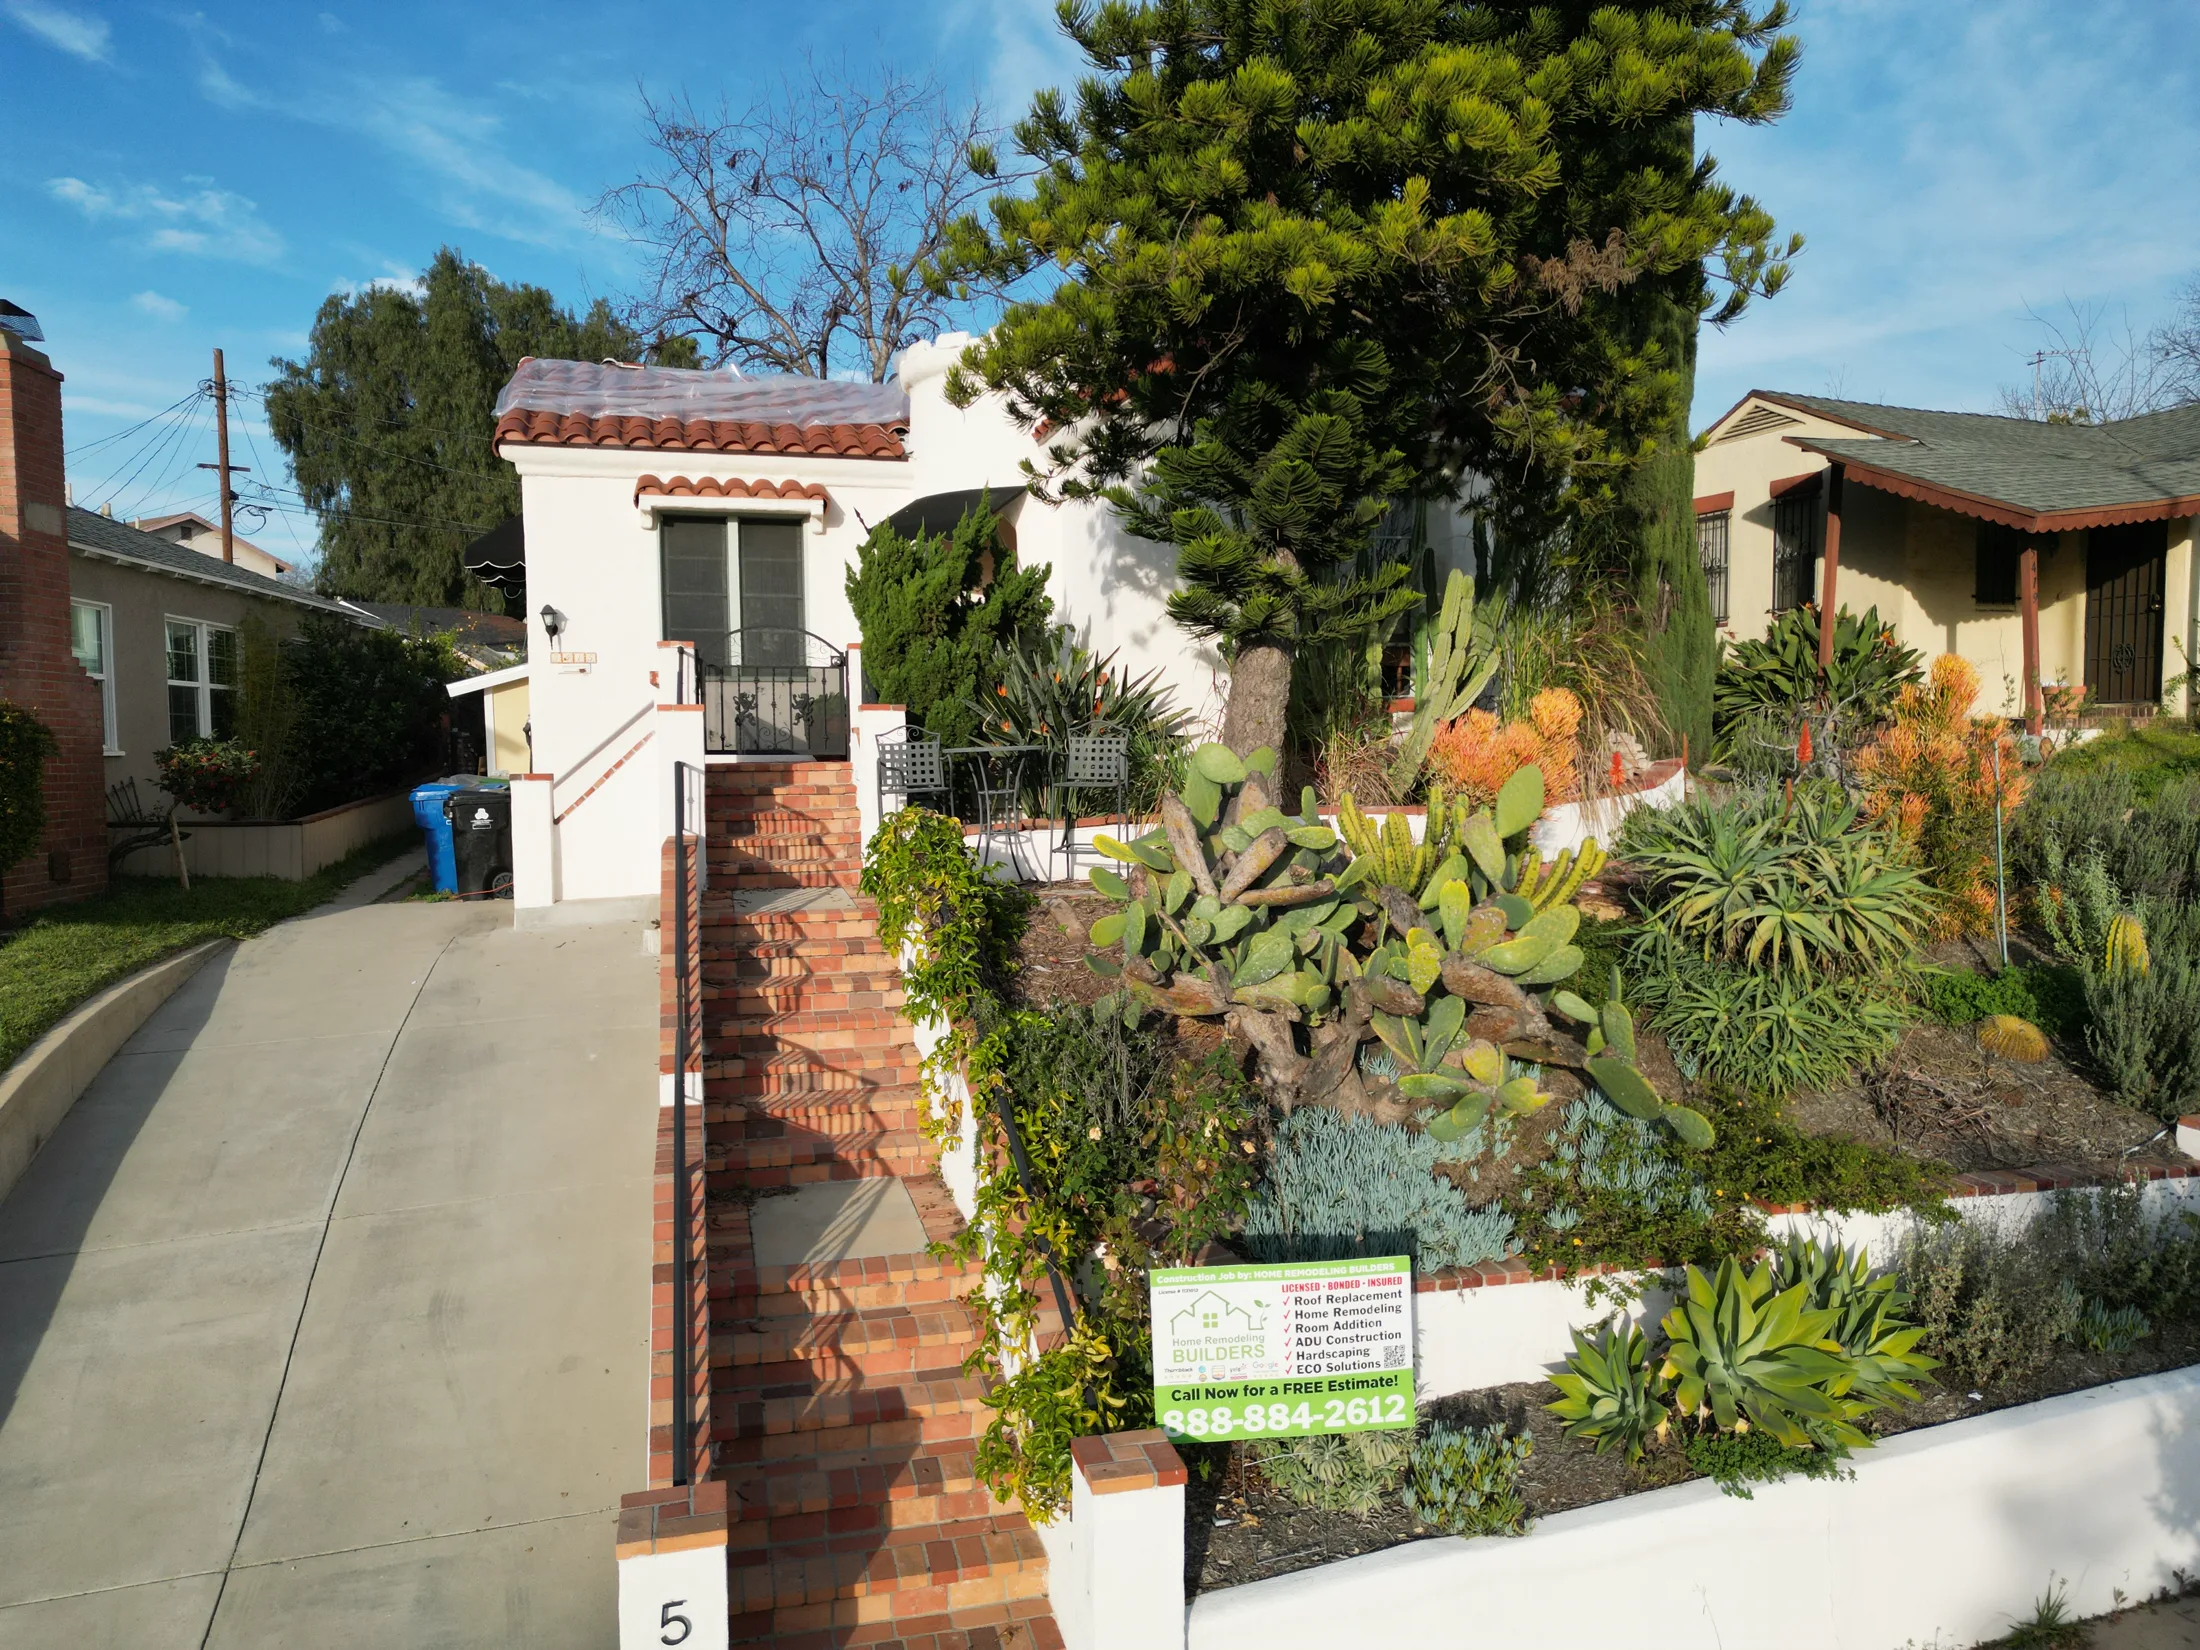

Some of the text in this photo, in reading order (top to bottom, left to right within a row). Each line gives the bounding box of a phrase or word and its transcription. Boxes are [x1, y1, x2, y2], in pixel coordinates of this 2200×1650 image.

[1157, 1263, 1395, 1284] Construction Job by: HOME REMODELING BUILDERS
[1282, 1276, 1403, 1293] LICENSED BONDED INSURED
[1294, 1290, 1402, 1306] Roof Replacement
[1295, 1303, 1402, 1319] Home Remodeling
[1295, 1319, 1382, 1333] Room Addition
[1172, 1334, 1265, 1347] Home Remodeling
[1296, 1331, 1402, 1347] ADU Construction
[1173, 1344, 1265, 1364] BUILDERS
[1296, 1347, 1370, 1361] Hardscaping
[1297, 1360, 1381, 1375] ECO Solutions
[1171, 1375, 1398, 1401] Call Now for a FREE Estimate!
[1163, 1394, 1406, 1438] 888-884-2612
[661, 1600, 692, 1646] 5
